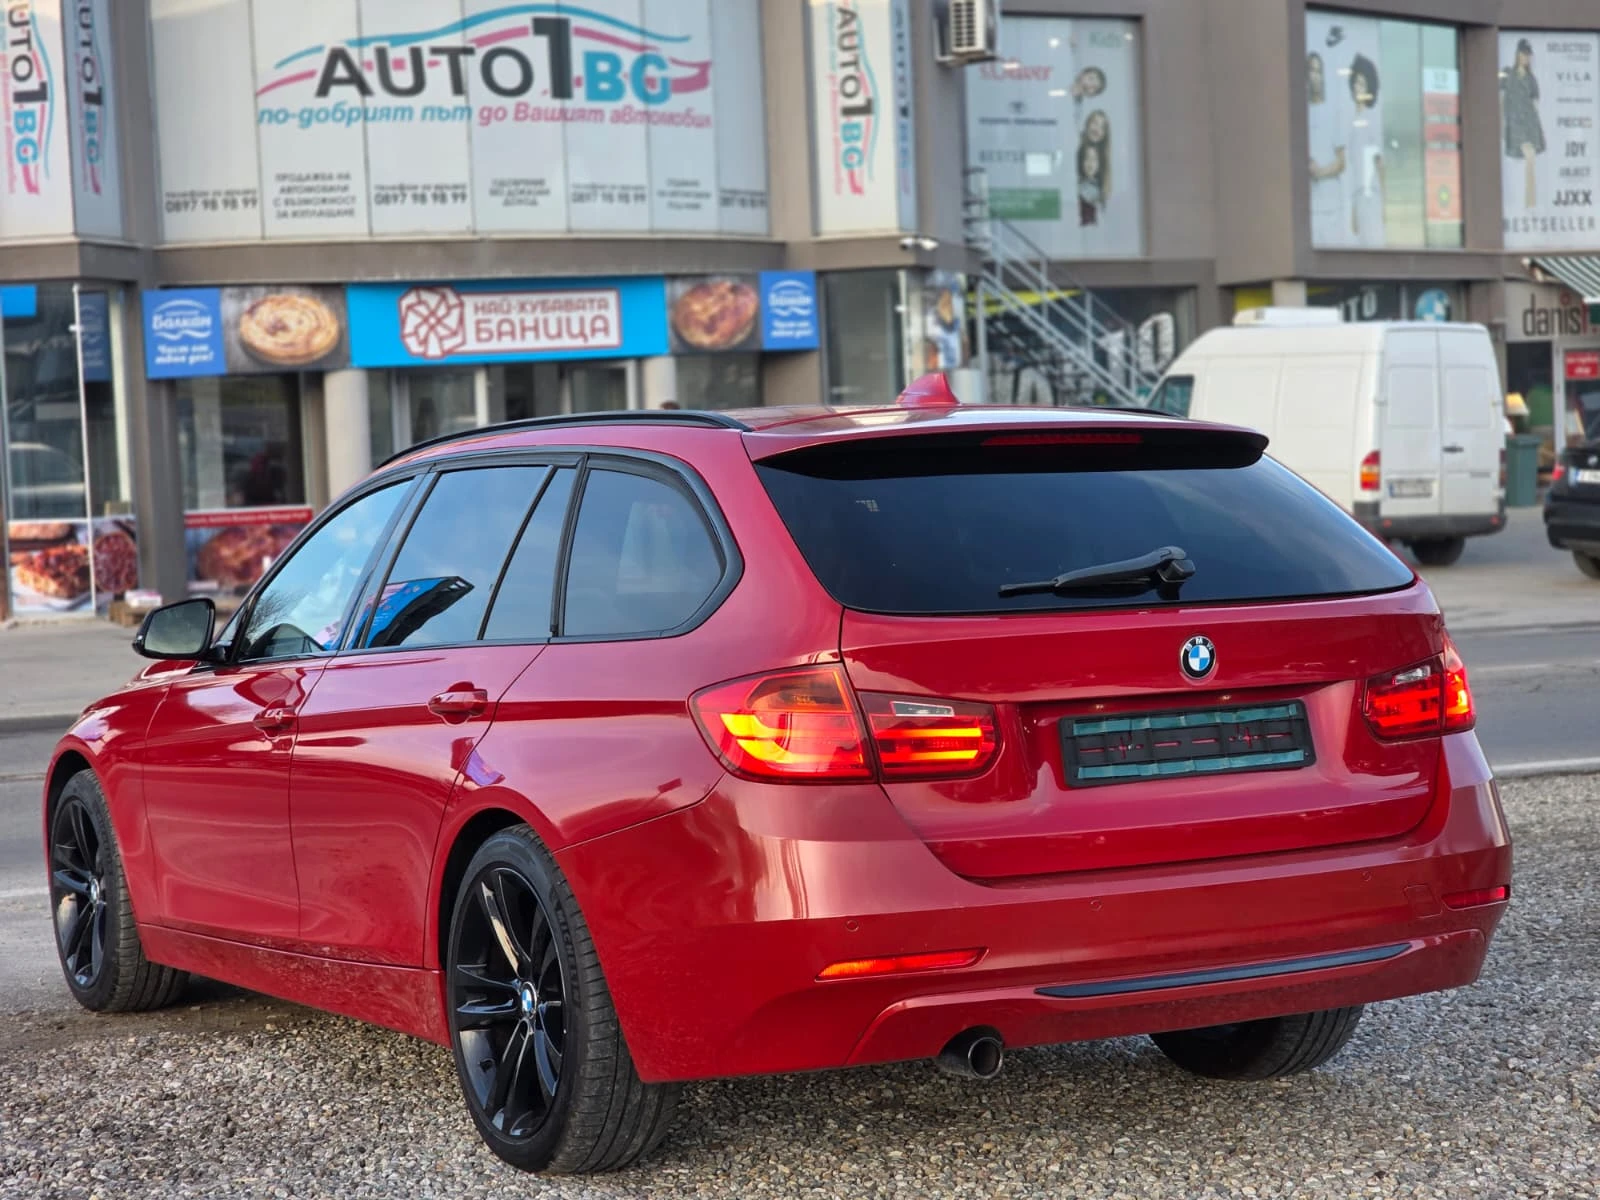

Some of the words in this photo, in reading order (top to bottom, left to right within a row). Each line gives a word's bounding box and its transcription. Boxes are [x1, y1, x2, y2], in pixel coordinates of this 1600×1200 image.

[8, 0, 49, 166] UTO1BG
[78, 0, 104, 165] UTO1BG
[1555, 71, 1592, 82] VILA
[258, 101, 415, 129] по-добрият
[421, 104, 473, 123] път
[478, 103, 508, 126] до
[513, 102, 605, 123] Вашият
[1552, 189, 1593, 207] JJXX
[473, 297, 610, 316] НАЙ-ХУБАВАТА
[474, 314, 611, 344] БАНИЦА
[1185, 637, 1215, 652] BMW
